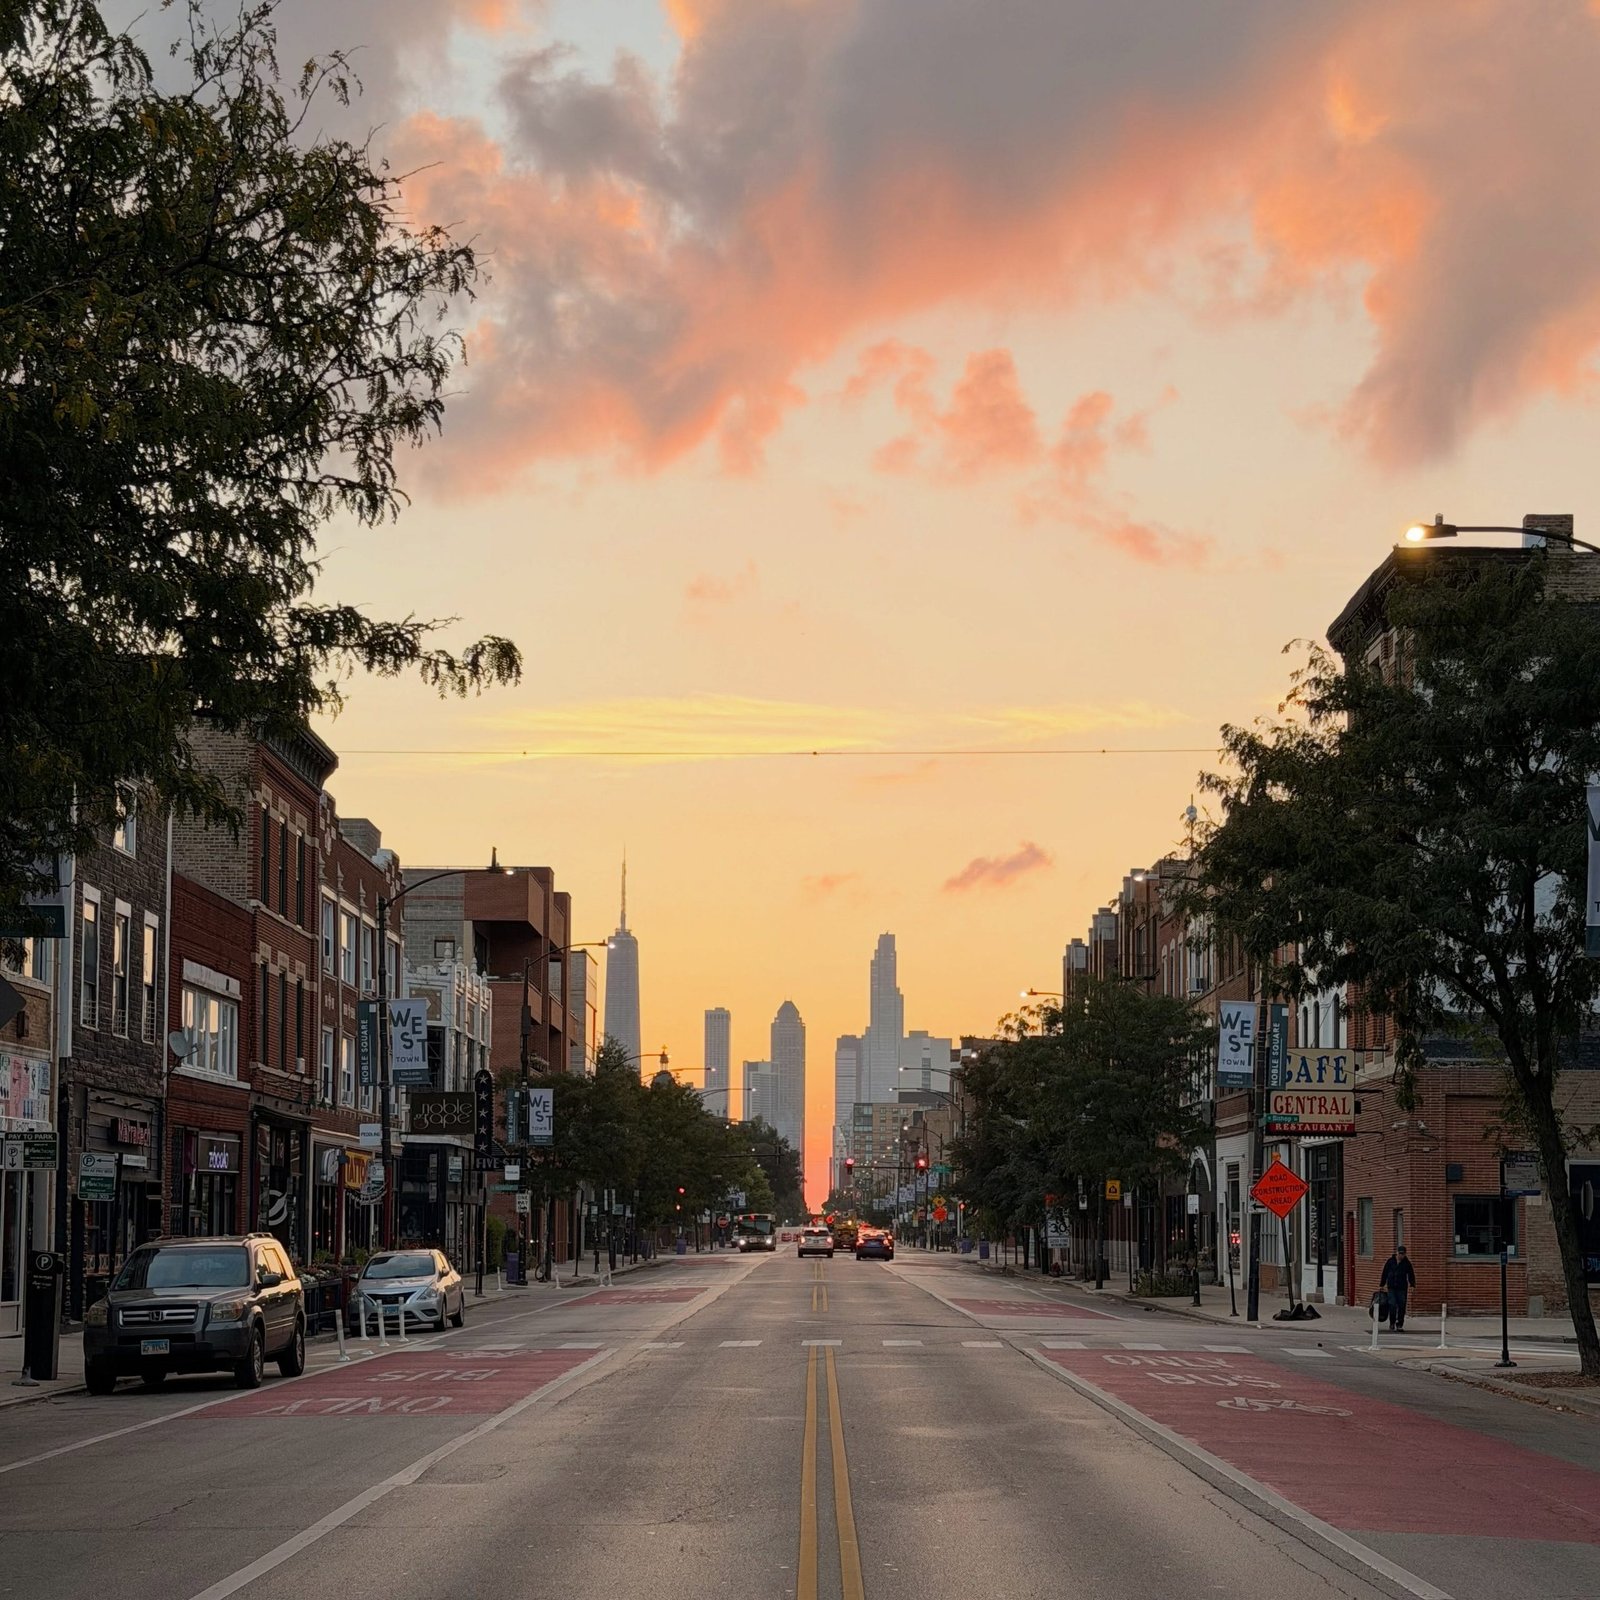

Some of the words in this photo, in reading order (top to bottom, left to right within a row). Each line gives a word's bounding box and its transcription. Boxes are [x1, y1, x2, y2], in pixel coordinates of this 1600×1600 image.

[389, 1008, 428, 1062] WEST
[1219, 1010, 1255, 1066] WEST
[1272, 1022, 1280, 1056] SQUARE
[361, 1056, 369, 1083] NOBLE
[1222, 1058, 1246, 1066] TOWN
[1271, 1059, 1279, 1086] NOBLE
[422, 1098, 473, 1115] noble
[529, 1095, 554, 1131] WEST
[1274, 1095, 1351, 1115] CENTRAL
[413, 1112, 471, 1130] grape
[1275, 1123, 1350, 1131] RESTAURANT
[476, 1157, 500, 1169] FIVE
[1269, 1174, 1287, 1182] ROAD
[1254, 1184, 1305, 1196] CONSTRUCTION
[1101, 1354, 1235, 1369] ONLY
[365, 1368, 502, 1382] BUS
[1145, 1372, 1282, 1388] BUS
[252, 1396, 453, 1415] ONLY
